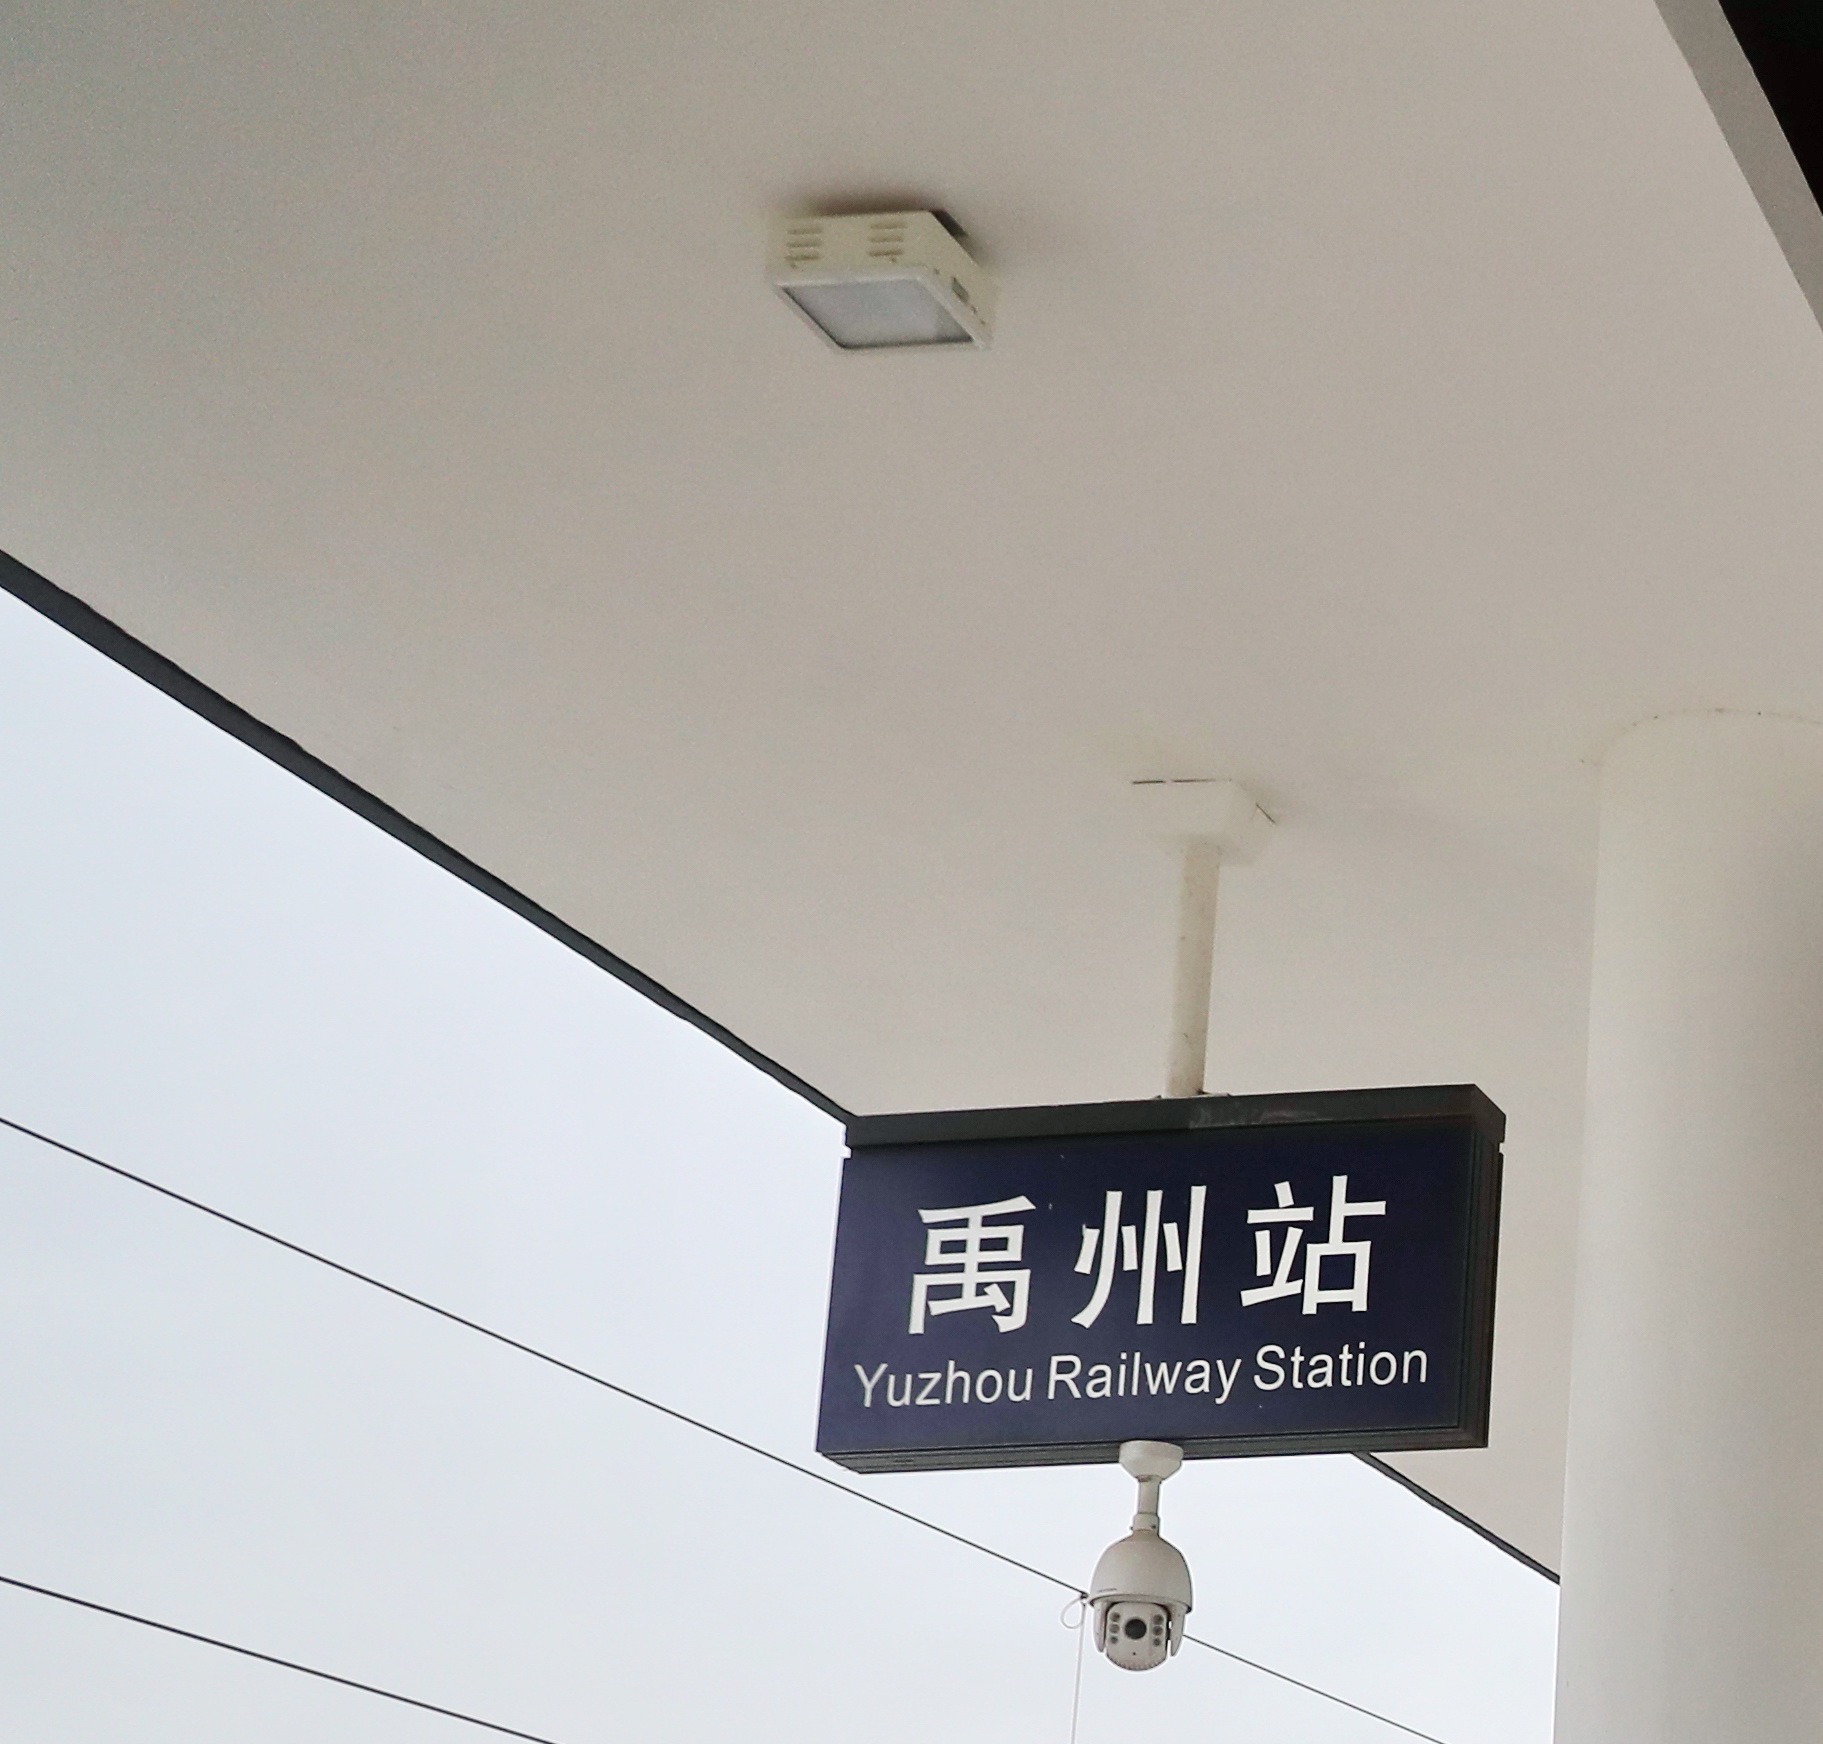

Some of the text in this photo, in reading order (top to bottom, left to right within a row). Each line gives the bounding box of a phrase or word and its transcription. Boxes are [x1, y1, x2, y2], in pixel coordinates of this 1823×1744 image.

[908, 1174, 1388, 1335] 禹州站
[853, 1341, 1428, 1409] Yuzhou Railway Station
